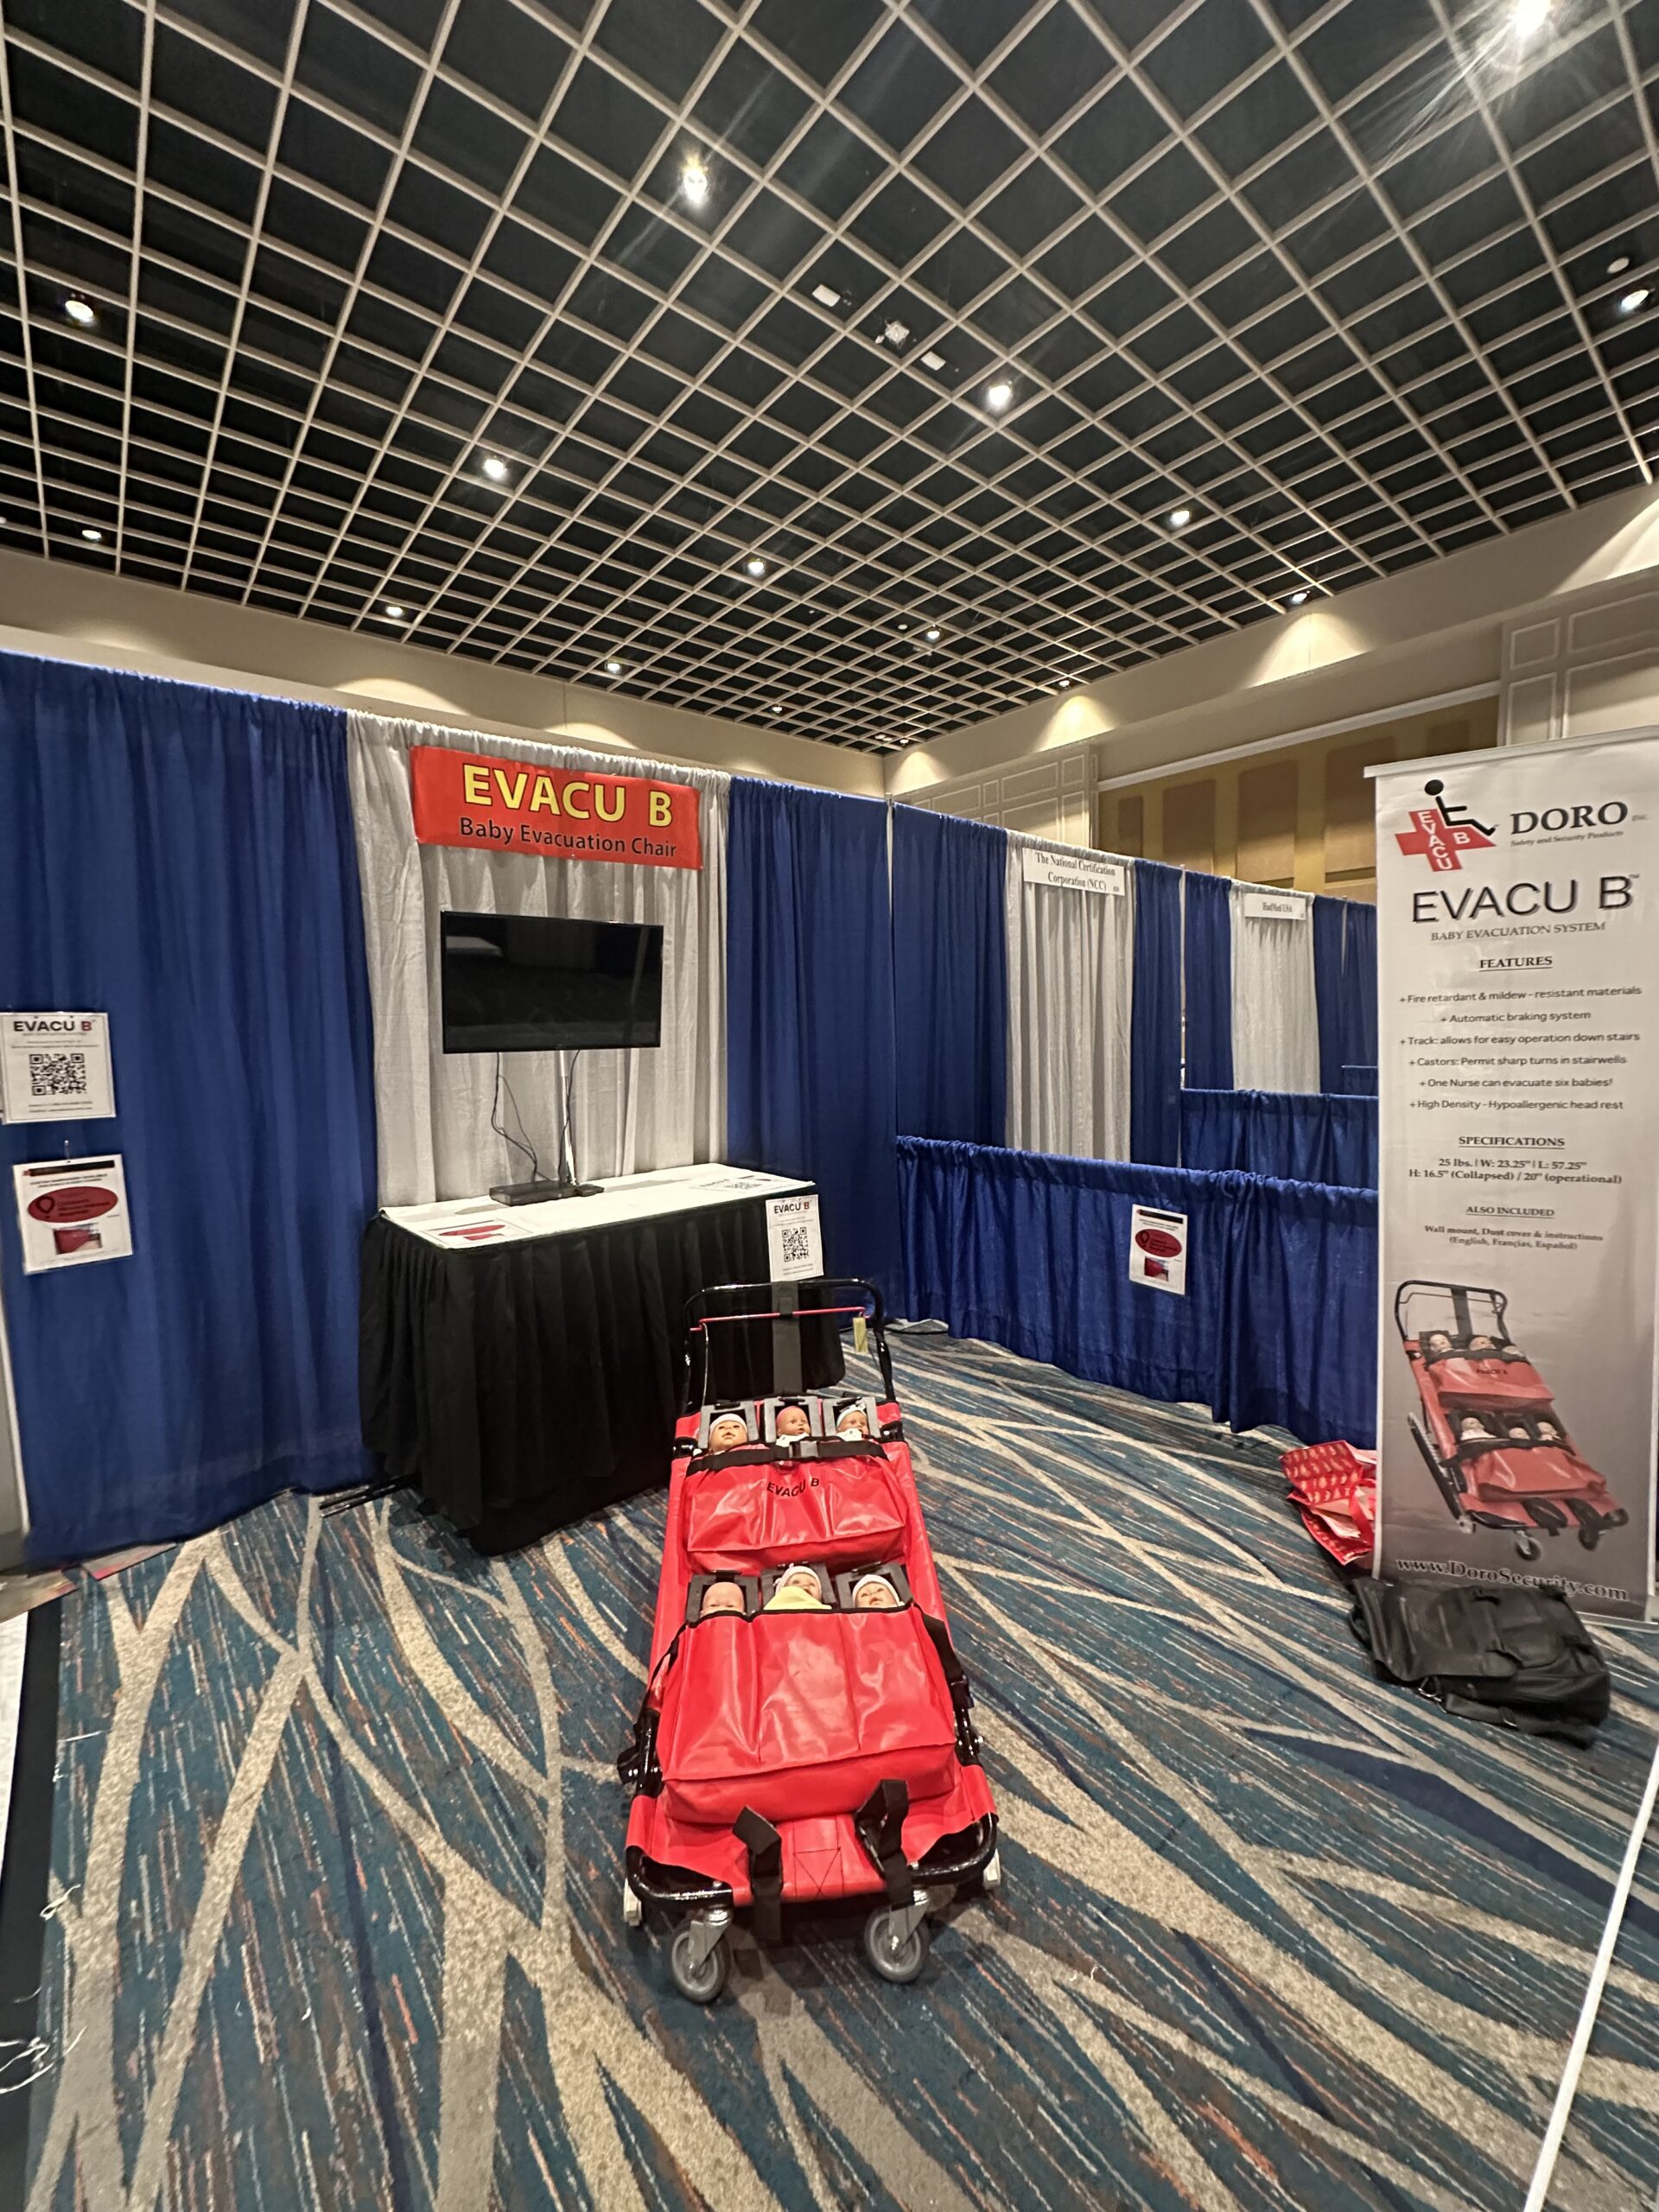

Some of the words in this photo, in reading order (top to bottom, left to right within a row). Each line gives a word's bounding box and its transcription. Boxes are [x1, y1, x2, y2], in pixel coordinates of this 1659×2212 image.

[461, 763, 626, 822] EVACU
[648, 790, 673, 827] B
[1510, 801, 1629, 835] DORO
[460, 817, 513, 845] Baby
[520, 825, 626, 853] Evacuation
[632, 837, 677, 857] Chair
[1452, 832, 1471, 845] B
[1536, 836, 1552, 844] and
[1035, 852, 1050, 865] The
[1051, 855, 1077, 870] National
[1078, 861, 1116, 876] Certification
[1047, 872, 1086, 887] Corporation
[1412, 879, 1577, 923] EVACU
[1430, 930, 1464, 941] BABY
[1465, 925, 1552, 939] EVACUATION
[1554, 922, 1605, 933] SYSTEM
[1479, 956, 1554, 969] FEATURES
[1407, 995, 1427, 1003] Fire
[1427, 992, 1477, 1002] retardant
[1586, 986, 1643, 996] materials
[1449, 1013, 1505, 1023] Automatic
[1506, 1012, 1548, 1023] braking
[1548, 1011, 1592, 1020] system
[13, 1020, 75, 1032] EVACU
[80, 1020, 92, 1032] B
[1440, 1035, 1471, 1045] allows
[1473, 1034, 1490, 1044] for
[1491, 1036, 1516, 1046] easy
[1517, 1033, 1572, 1045] operation
[1573, 1032, 1605, 1042] down
[1605, 1031, 1641, 1042] stairs
[1417, 1057, 1459, 1066] Castors:
[1460, 1056, 1496, 1065] Permit
[1497, 1055, 1529, 1066] sharp
[1529, 1056, 1559, 1065] turns
[1560, 1055, 1571, 1064] in
[1572, 1054, 1627, 1065] stairwells
[1427, 1078, 1449, 1087] One
[1450, 1078, 1481, 1087] Nurse
[1503, 1078, 1554, 1087] evacuate
[1554, 1078, 1570, 1087] six
[1417, 1099, 1440, 1110] High
[1441, 1099, 1481, 1110] Density
[1488, 1099, 1568, 1110] Hypoallergenic
[1570, 1100, 1599, 1109] head
[1600, 1101, 1624, 1110] rest
[1459, 1135, 1566, 1147] SPECIFICATIONS
[1439, 1158, 1451, 1166] 25
[1453, 1158, 1473, 1167] lbs.
[1480, 1159, 1495, 1167] W:
[1451, 1170, 1514, 1182] (Collapsed)
[1544, 1173, 1623, 1185] (operational)
[774, 1203, 801, 1214] EVACU
[1497, 1206, 1554, 1216] INCLUDED
[1544, 1231, 1604, 1241] instructions
[766, 1479, 806, 1497] EVACU
[810, 1478, 819, 1487] B
